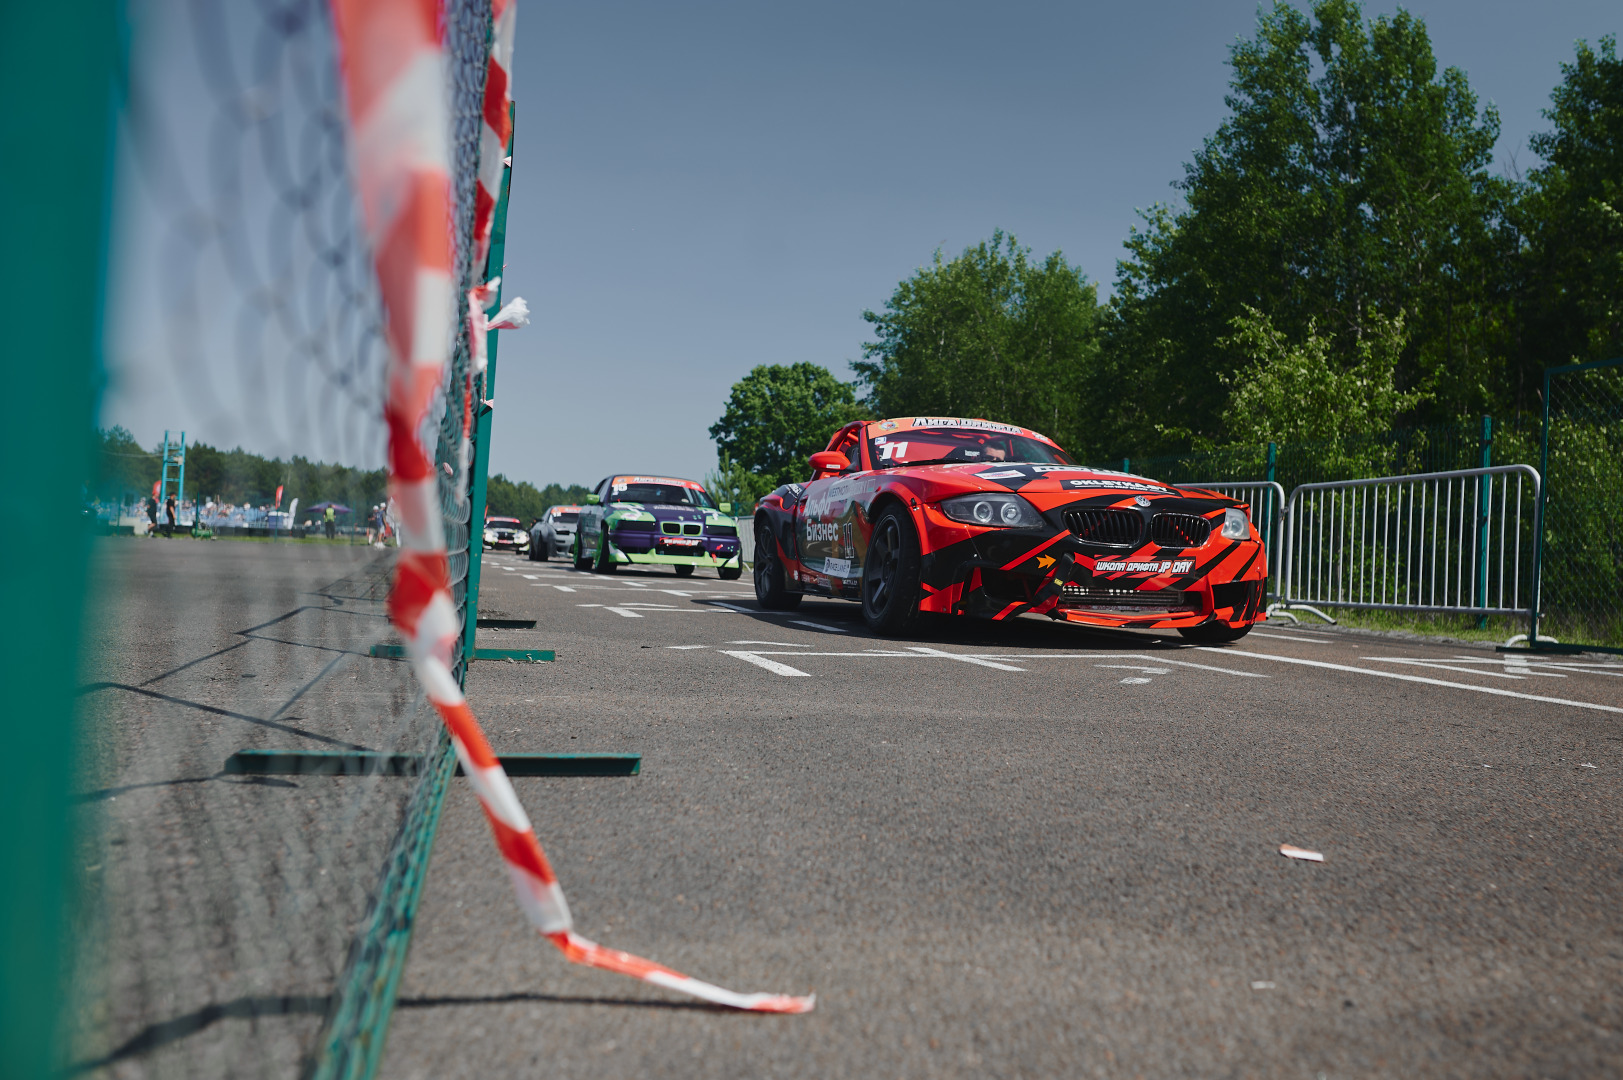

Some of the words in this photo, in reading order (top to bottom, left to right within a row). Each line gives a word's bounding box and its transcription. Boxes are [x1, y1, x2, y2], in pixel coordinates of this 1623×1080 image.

[879, 442, 908, 459] 11
[612, 484, 627, 492] 15
[806, 518, 839, 542] Бизнес
[1095, 561, 1127, 572] ШКОЛА
[1125, 562, 1160, 572] ДРИФТА
[1158, 561, 1172, 574] JP
[1171, 561, 1193, 574] DAY
